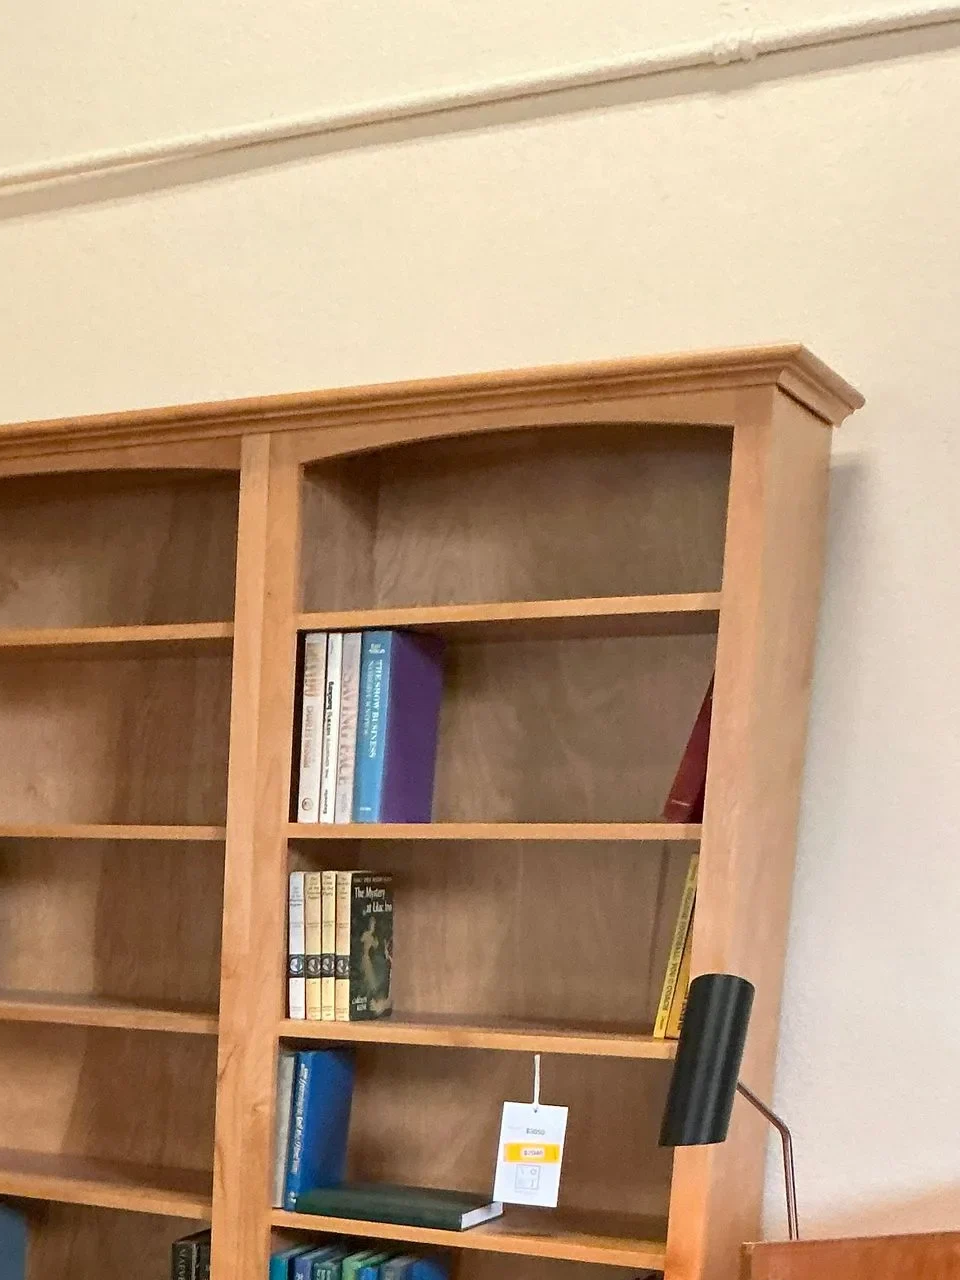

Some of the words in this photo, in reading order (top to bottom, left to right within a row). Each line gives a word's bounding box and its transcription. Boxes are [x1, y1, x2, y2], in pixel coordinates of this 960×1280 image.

[372, 678, 382, 710] SHOW
[368, 711, 379, 758] BUSINESS
[354, 886, 365, 899] The
[365, 886, 385, 901] Mystery
